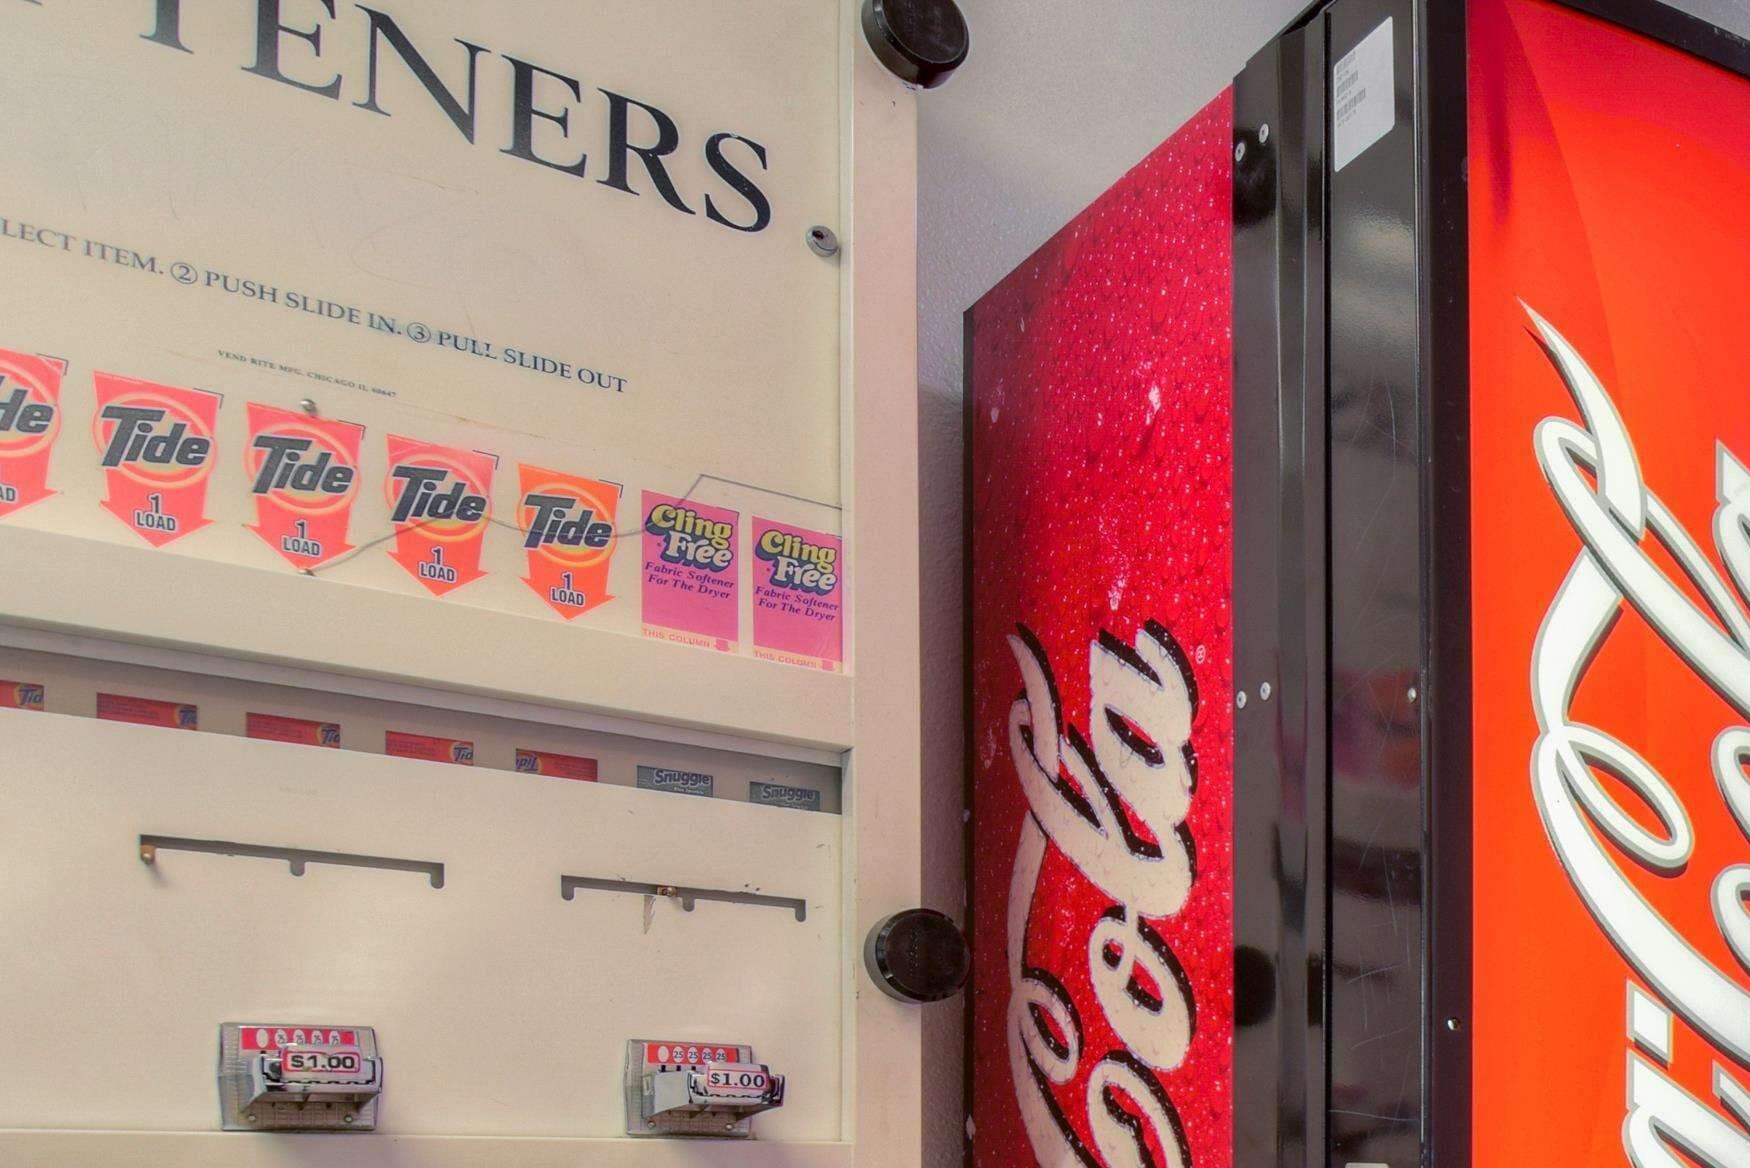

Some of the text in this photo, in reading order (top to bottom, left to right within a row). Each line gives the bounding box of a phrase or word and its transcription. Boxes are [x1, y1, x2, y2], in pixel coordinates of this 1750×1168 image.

[83, 239, 164, 275] ITEM.
[204, 269, 278, 304] PUSH
[285, 291, 361, 325] SLIDE
[368, 312, 402, 335] IN.
[437, 330, 497, 360] PULL
[503, 348, 573, 379] SLIDE
[577, 367, 627, 393] OUT
[101, 404, 211, 467] Tide
[252, 434, 355, 494] Tide
[390, 465, 488, 522] Tide
[148, 494, 161, 514] 1
[135, 512, 176, 532] LOAD
[296, 520, 309, 540] 1
[523, 494, 613, 550] Tide
[647, 503, 735, 550] Cling
[282, 538, 321, 557] LOAD
[431, 547, 443, 567] 1
[667, 530, 735, 569] Free
[760, 530, 839, 574] Cling
[420, 563, 456, 583] LOAD
[562, 573, 573, 590] 1
[645, 562, 736, 590] Fabric Softener
[774, 555, 839, 593] Free
[551, 588, 585, 607] LOAD
[648, 575, 731, 600] For The Dryer
[755, 586, 792, 601] Fabric
[758, 599, 836, 622] For The Dryer
[643, 628, 665, 639] THIS
[654, 769, 711, 787] Snuggle
[762, 786, 815, 801] Snuggle
[674, 1050, 725, 1060] 25 25 25 25
[711, 1072, 765, 1088] $1.00
